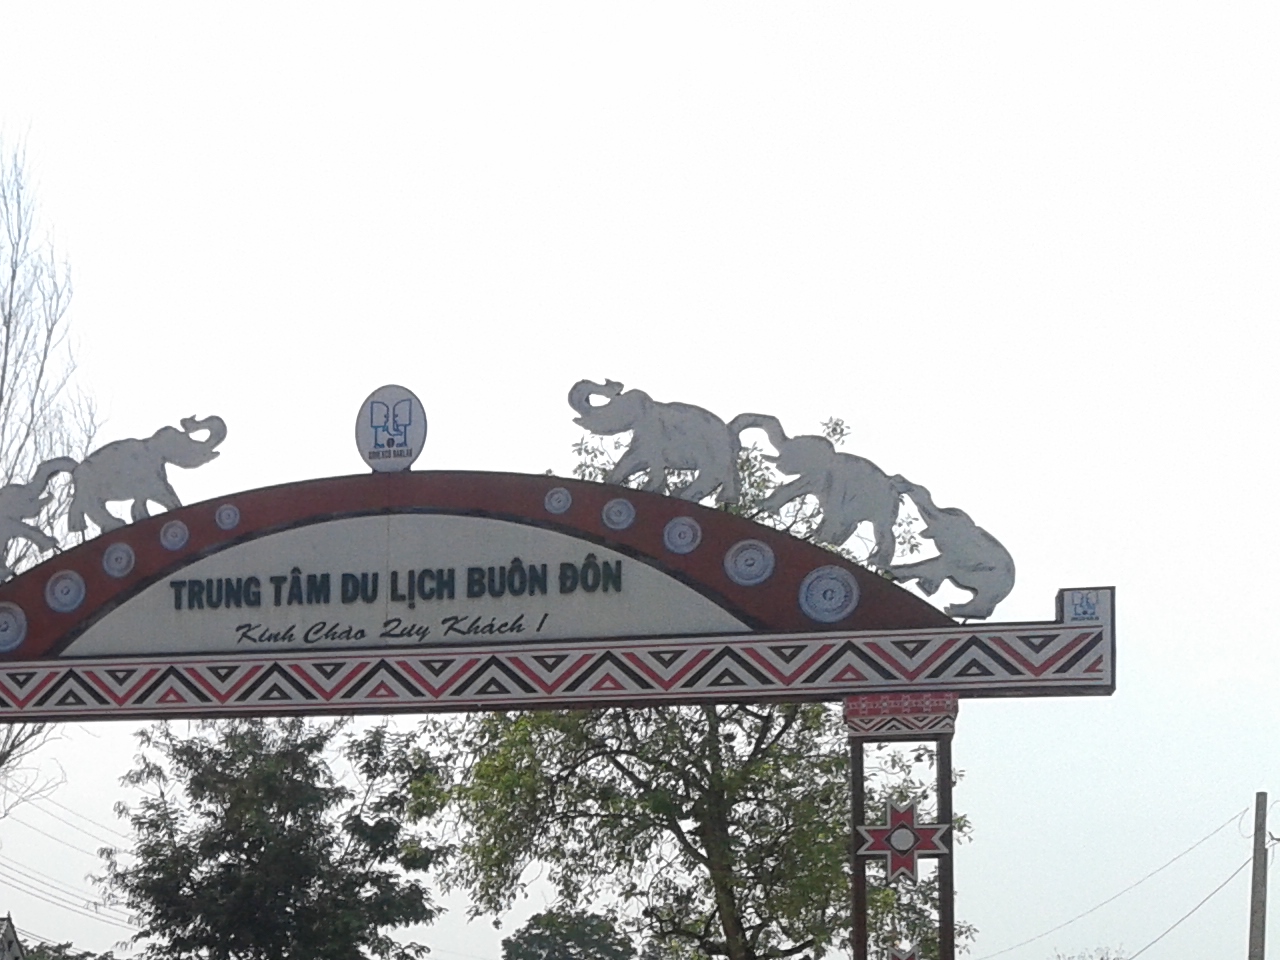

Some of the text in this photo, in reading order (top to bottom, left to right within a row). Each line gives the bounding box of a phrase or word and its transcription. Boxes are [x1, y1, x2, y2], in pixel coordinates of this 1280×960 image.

[170, 552, 622, 610] TRUNG TÂM DU LỊCH BUÔN ĐÔN
